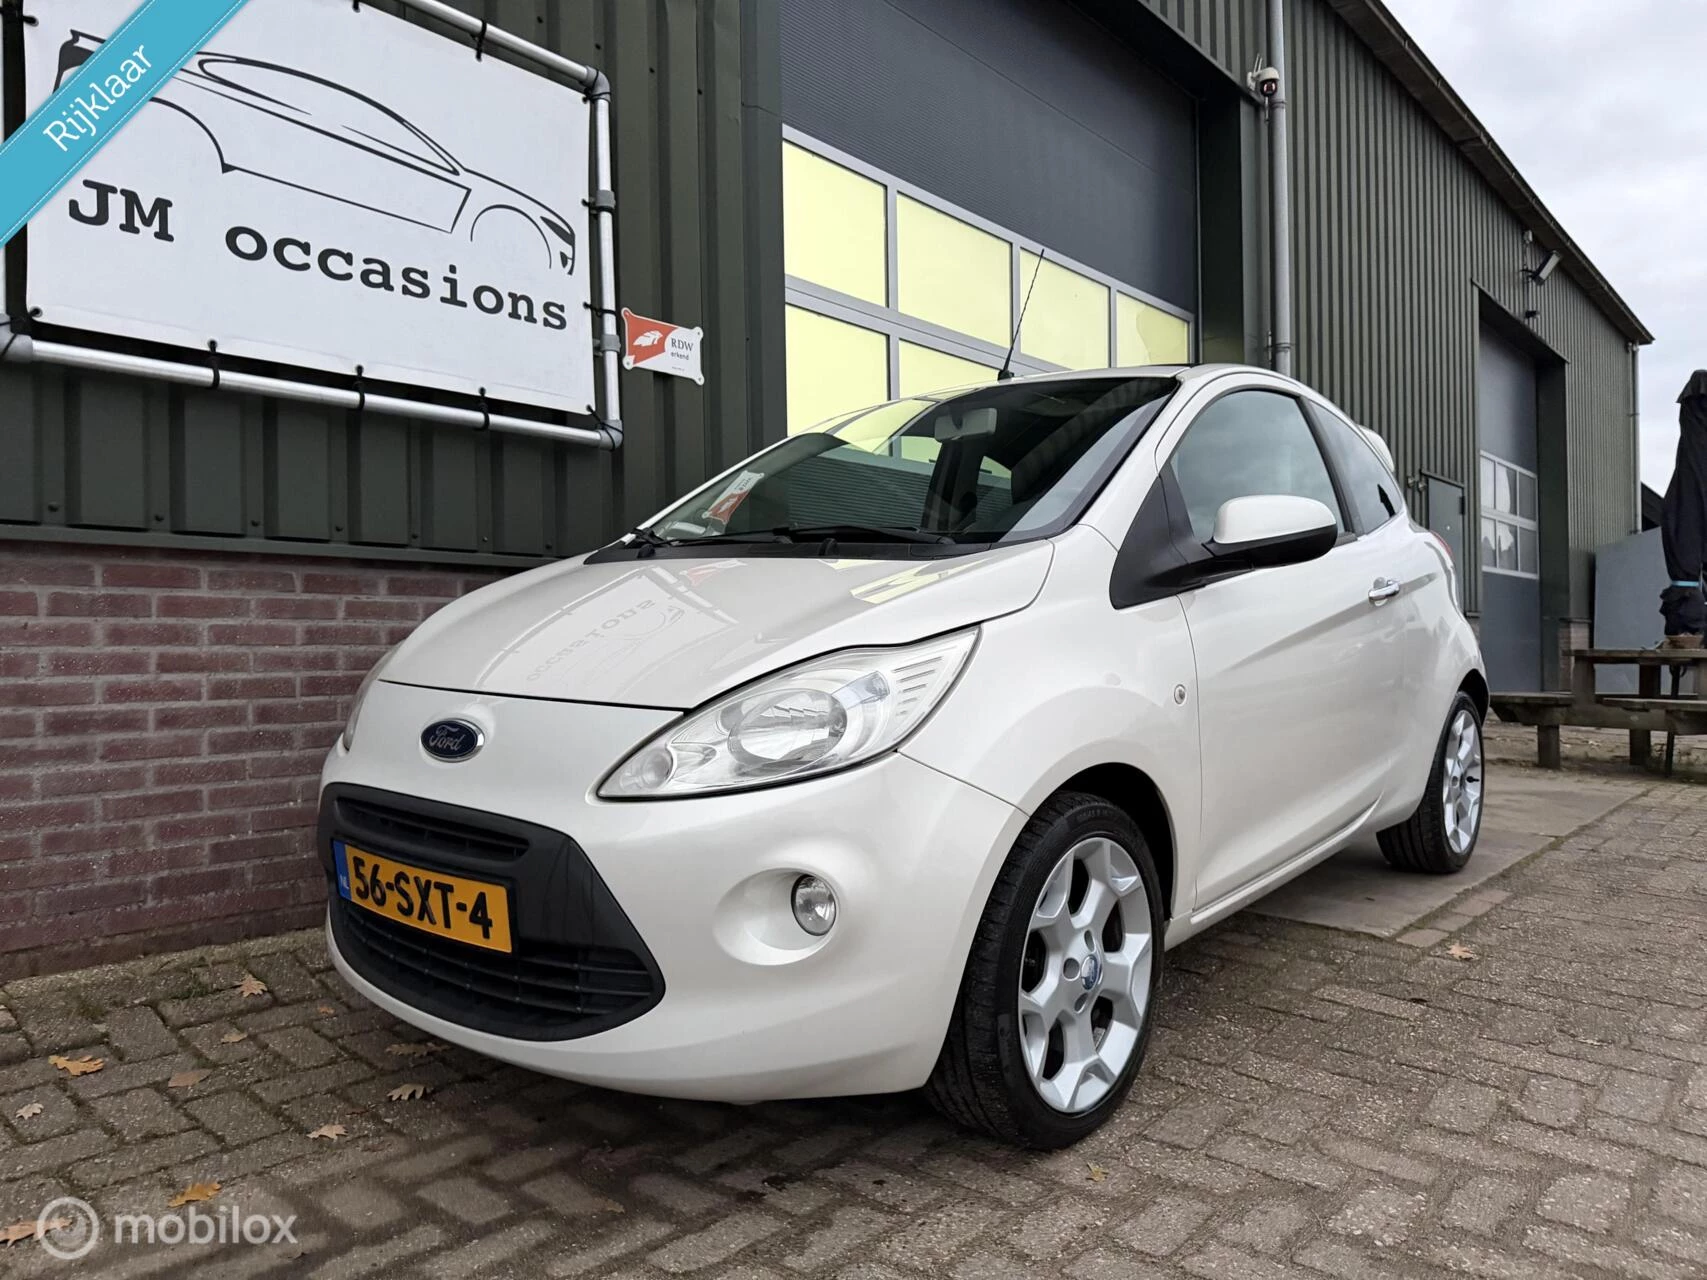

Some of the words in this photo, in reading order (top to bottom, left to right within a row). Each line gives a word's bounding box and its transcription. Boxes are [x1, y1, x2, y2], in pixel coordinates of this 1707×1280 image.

[69, 179, 175, 242] JM
[225, 225, 568, 331] occasions
[671, 338, 694, 351] RDW
[428, 725, 463, 751] Ford
[352, 855, 493, 939] 56-SXT-4
